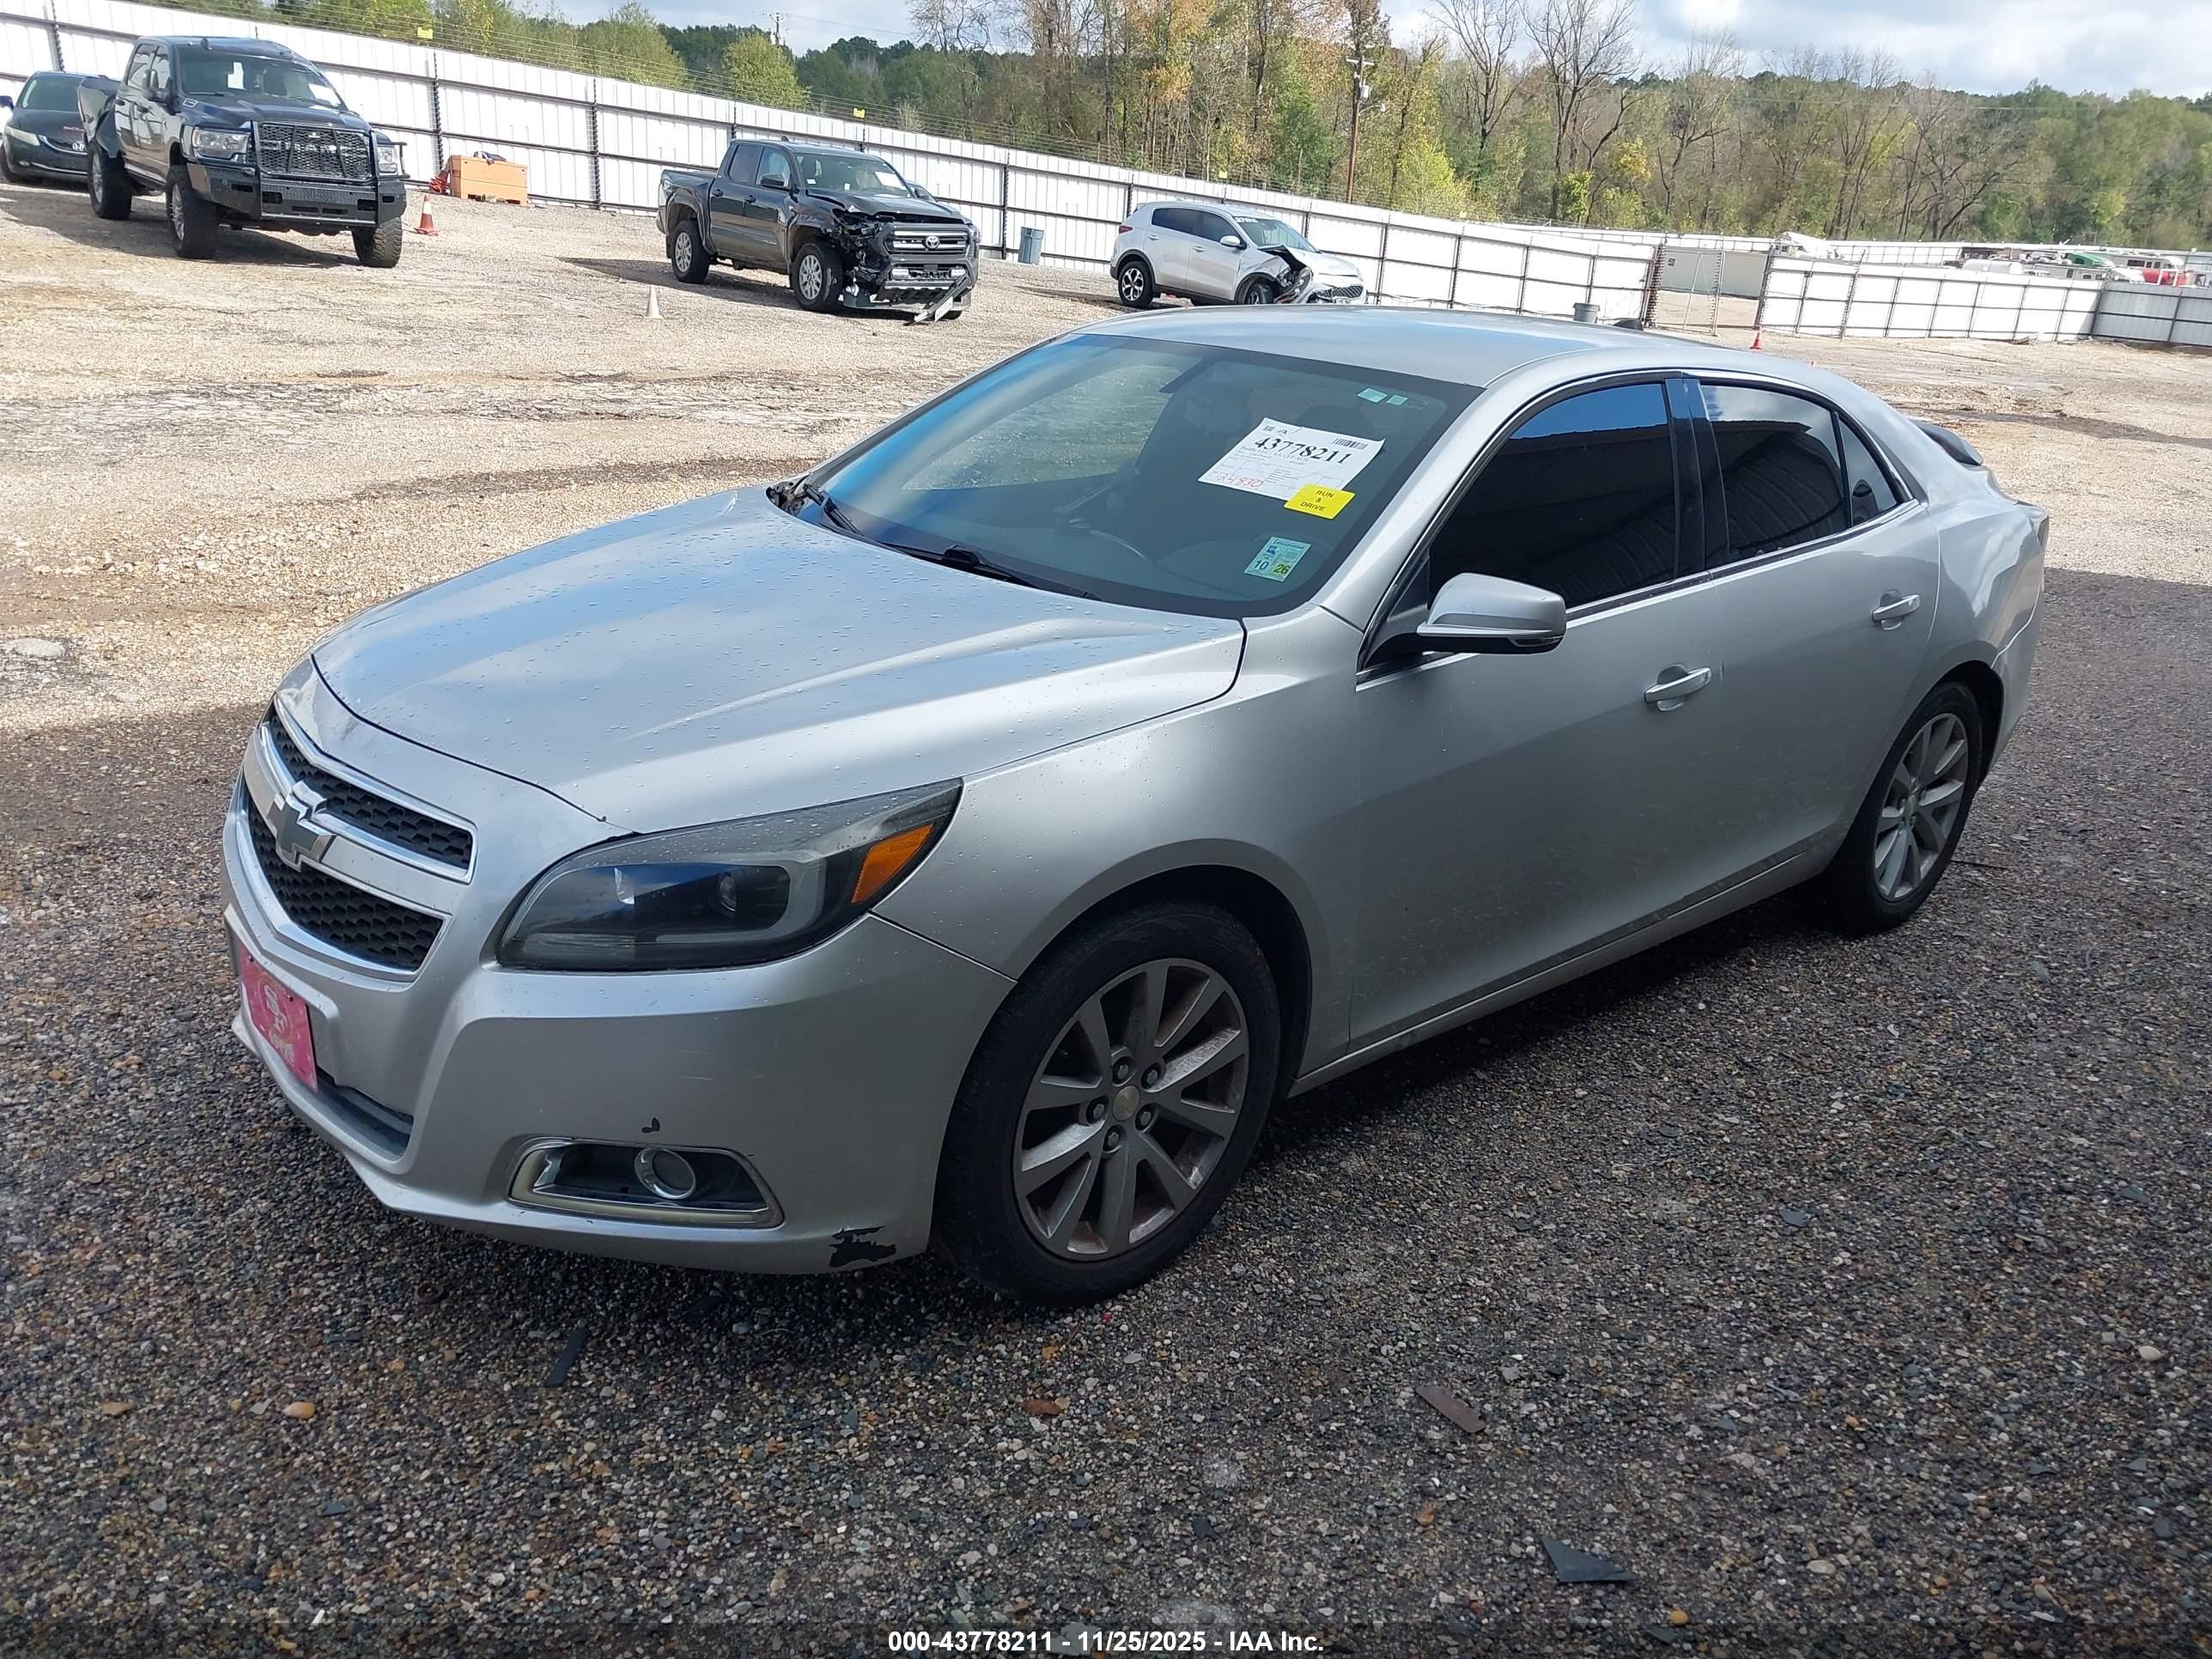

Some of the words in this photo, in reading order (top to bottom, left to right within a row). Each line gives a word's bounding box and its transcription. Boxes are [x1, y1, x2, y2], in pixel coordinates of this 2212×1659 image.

[1255, 438, 1352, 465] 43778211
[1300, 501, 1327, 512] DRIVE
[1255, 560, 1269, 570] 10
[1273, 564, 1291, 574] 26
